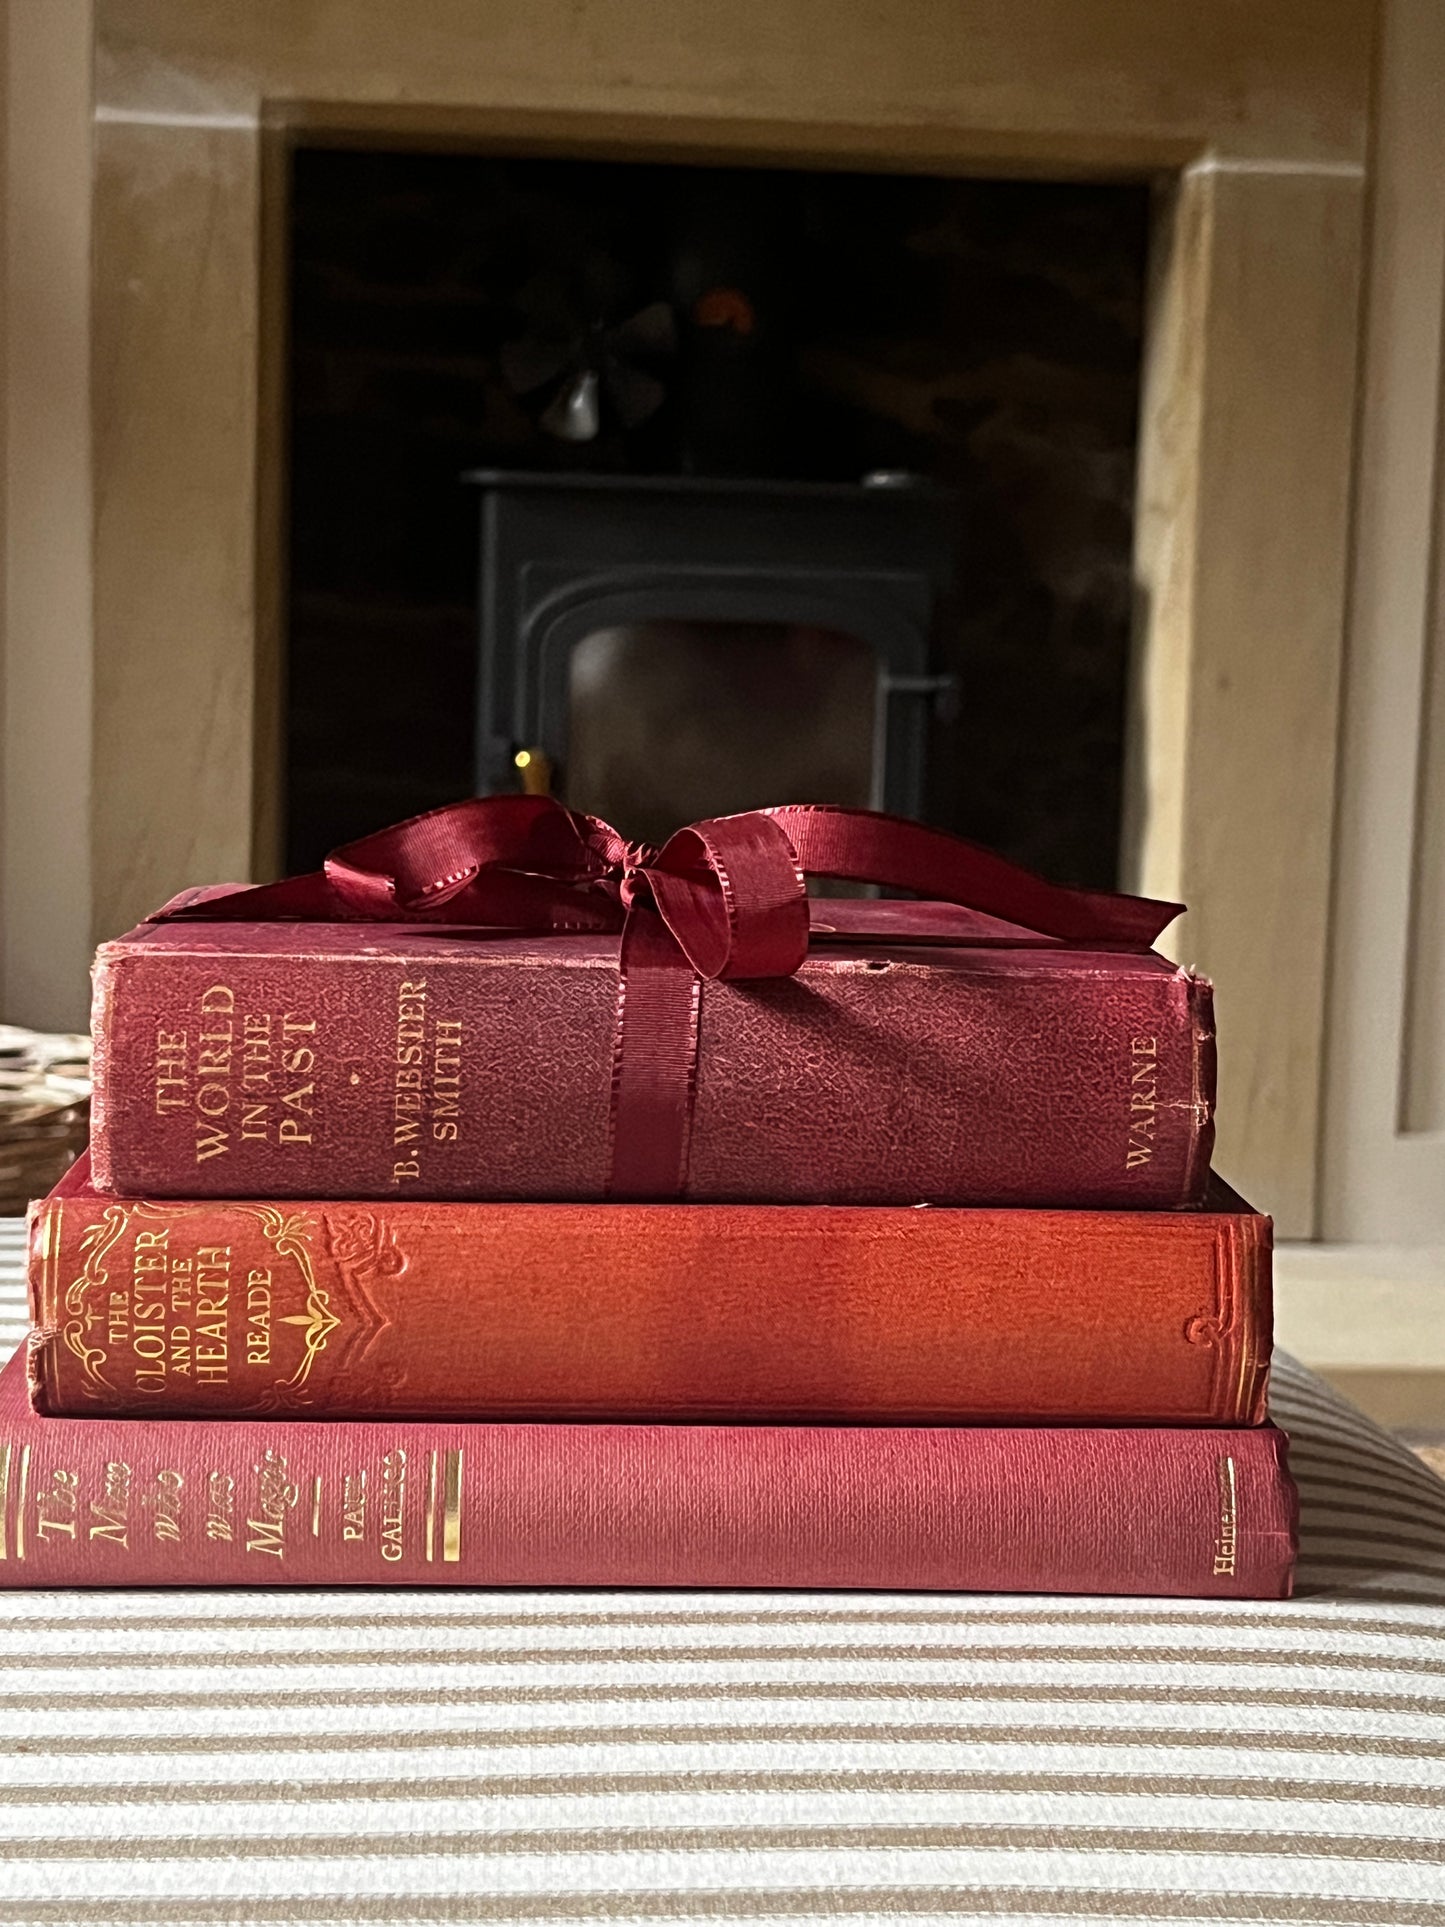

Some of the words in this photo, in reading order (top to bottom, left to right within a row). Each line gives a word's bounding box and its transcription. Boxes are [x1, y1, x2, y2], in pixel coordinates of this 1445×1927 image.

[156, 1030, 189, 1114] THE
[196, 985, 234, 1162] WORLD
[243, 1014, 271, 1085] THE
[279, 1012, 316, 1145] PAST
[433, 1020, 462, 1140] SMITH
[241, 1103, 268, 1140] IN
[1126, 1036, 1157, 1169] WARNE
[108, 1291, 128, 1344] THE
[133, 1229, 168, 1393] CLOISTER
[172, 1258, 192, 1312] THE
[196, 1246, 230, 1383] HEARTH
[247, 1268, 272, 1364] READE
[171, 1325, 191, 1376] AND
[36, 1470, 78, 1542] The
[141, 1470, 184, 1542] who
[205, 1471, 233, 1541] was
[246, 1449, 299, 1559] Magic
